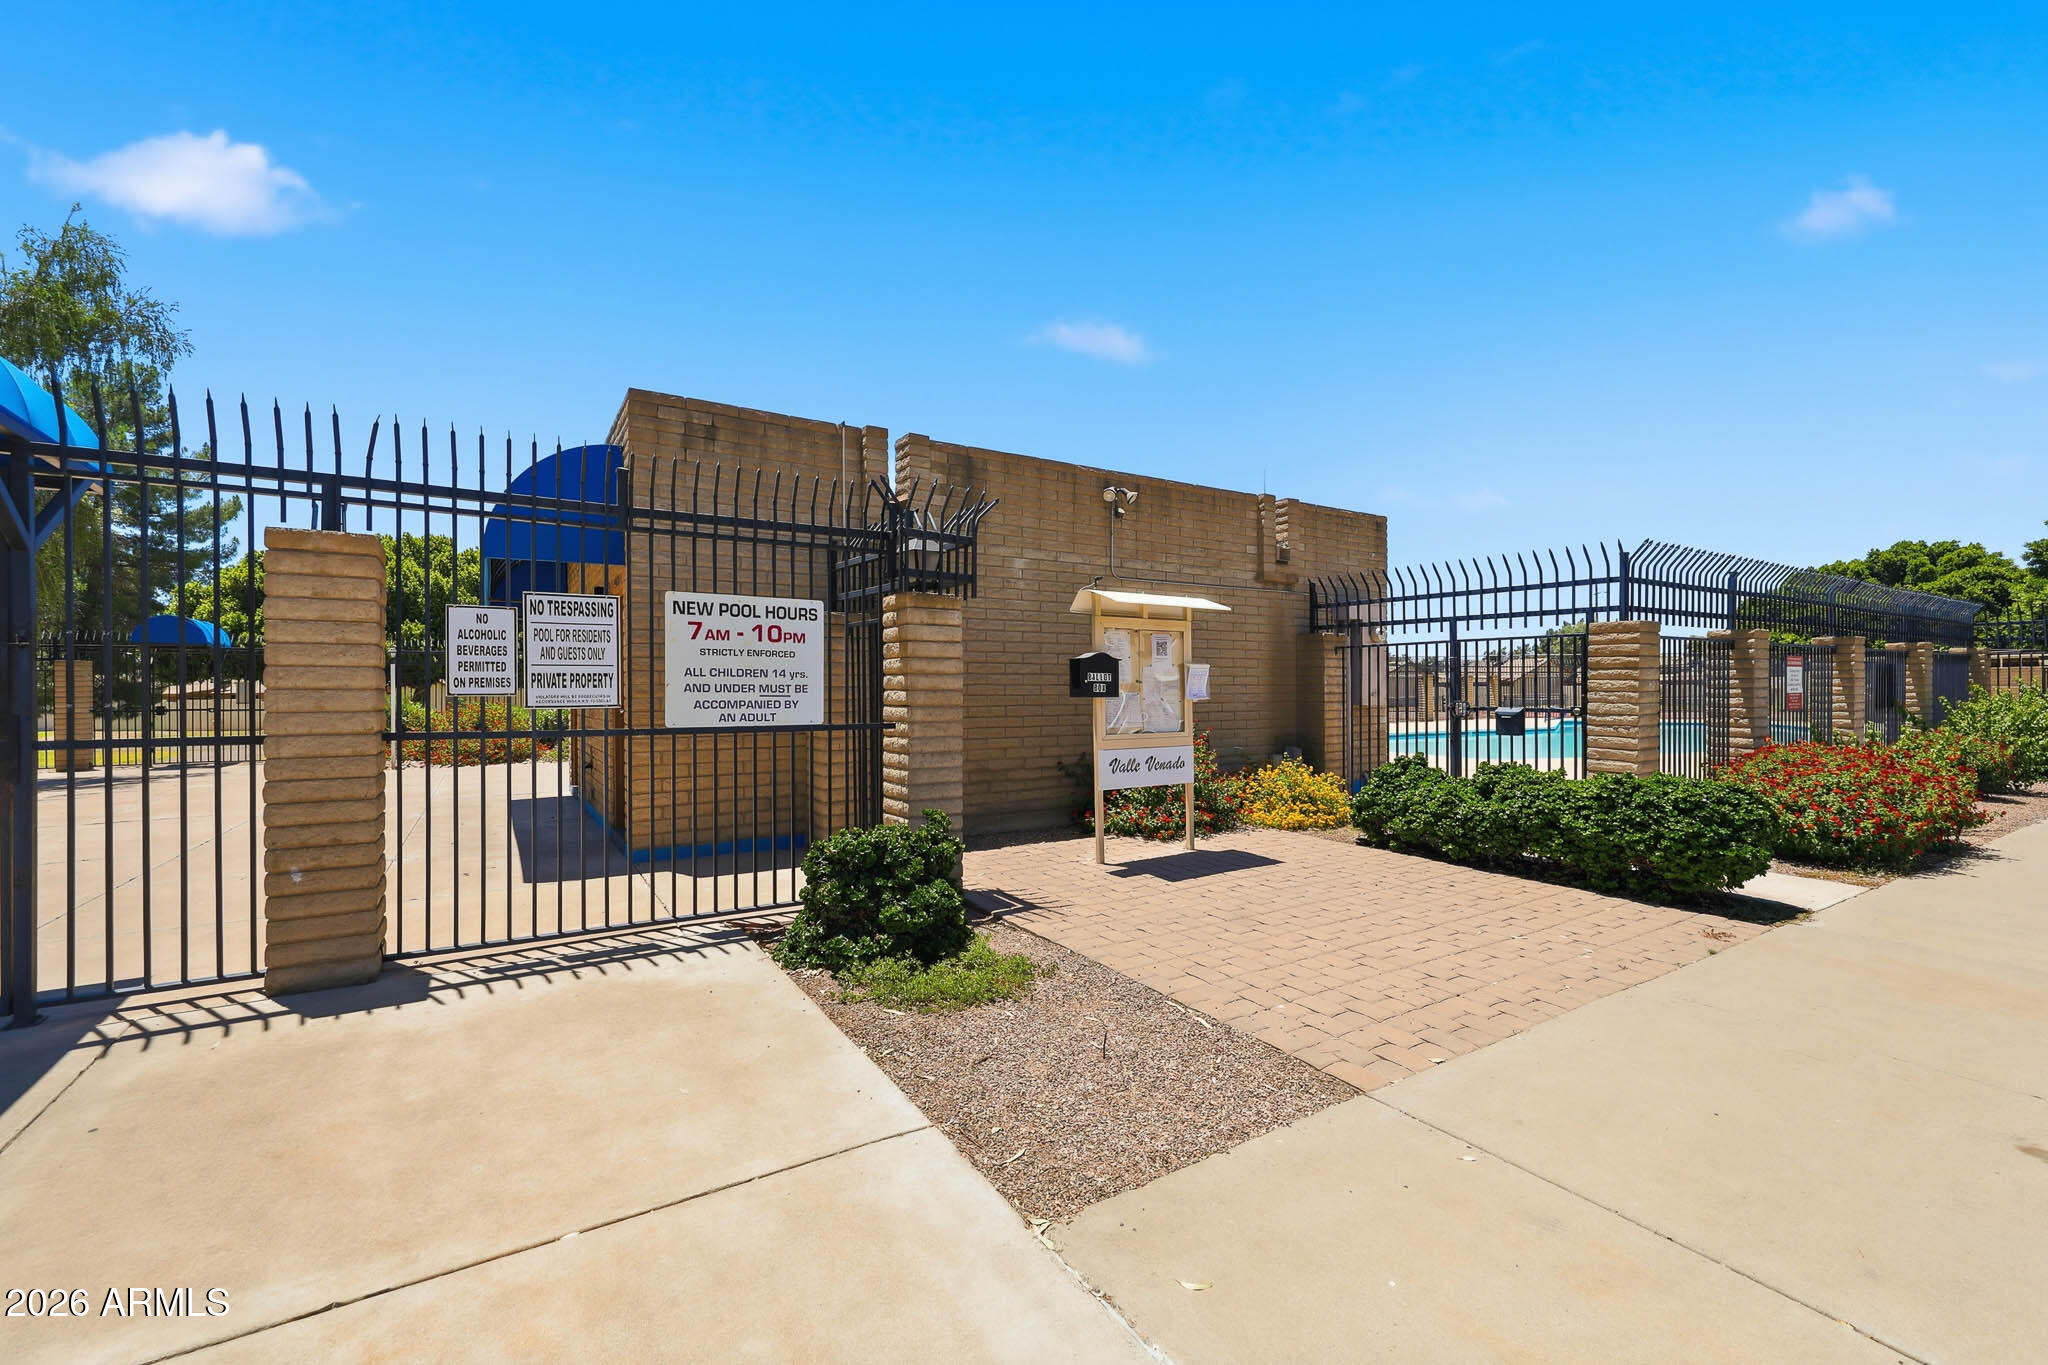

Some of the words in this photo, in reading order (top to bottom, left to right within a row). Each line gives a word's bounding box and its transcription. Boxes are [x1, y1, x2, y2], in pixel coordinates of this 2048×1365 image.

[530, 599, 544, 616] NO
[547, 600, 614, 618] TRESPASSING
[672, 600, 714, 616] NEW
[719, 603, 761, 618] POOL
[765, 605, 818, 621] HOURS
[476, 613, 489, 624] NO
[457, 629, 507, 640] ALCOHOLIC
[533, 628, 554, 642] POOL
[555, 629, 571, 642] FOR
[572, 629, 611, 644] RESIDENTS
[687, 621, 730, 641] 7AM
[751, 624, 806, 644] 10PM
[456, 645, 508, 656] BEVERAGES
[540, 647, 556, 660] AND
[557, 647, 587, 660] GUESTS
[587, 647, 606, 660] ONLY
[699, 648, 745, 657] STRICTLY
[747, 649, 796, 658] ENFORCED
[457, 661, 507, 672] PERMITTED
[684, 667, 706, 678] ALL
[709, 668, 768, 678] CHILDREN
[772, 669, 786, 678] 14
[789, 670, 808, 681] yrs.
[453, 677, 466, 688] ON
[468, 677, 511, 688] PREMISES
[531, 673, 567, 689] PRIVATE
[569, 672, 614, 689] PROPERTY
[683, 683, 711, 693] AND
[714, 683, 756, 693] UNDER
[759, 684, 791, 693] MUST
[794, 684, 808, 693] BE
[693, 699, 782, 709] ACCOMPANIED
[784, 700, 799, 709] BY
[718, 713, 736, 722] AN
[739, 712, 777, 722] ADULT
[1109, 757, 1141, 775] Valle
[1145, 755, 1185, 772] Venado
